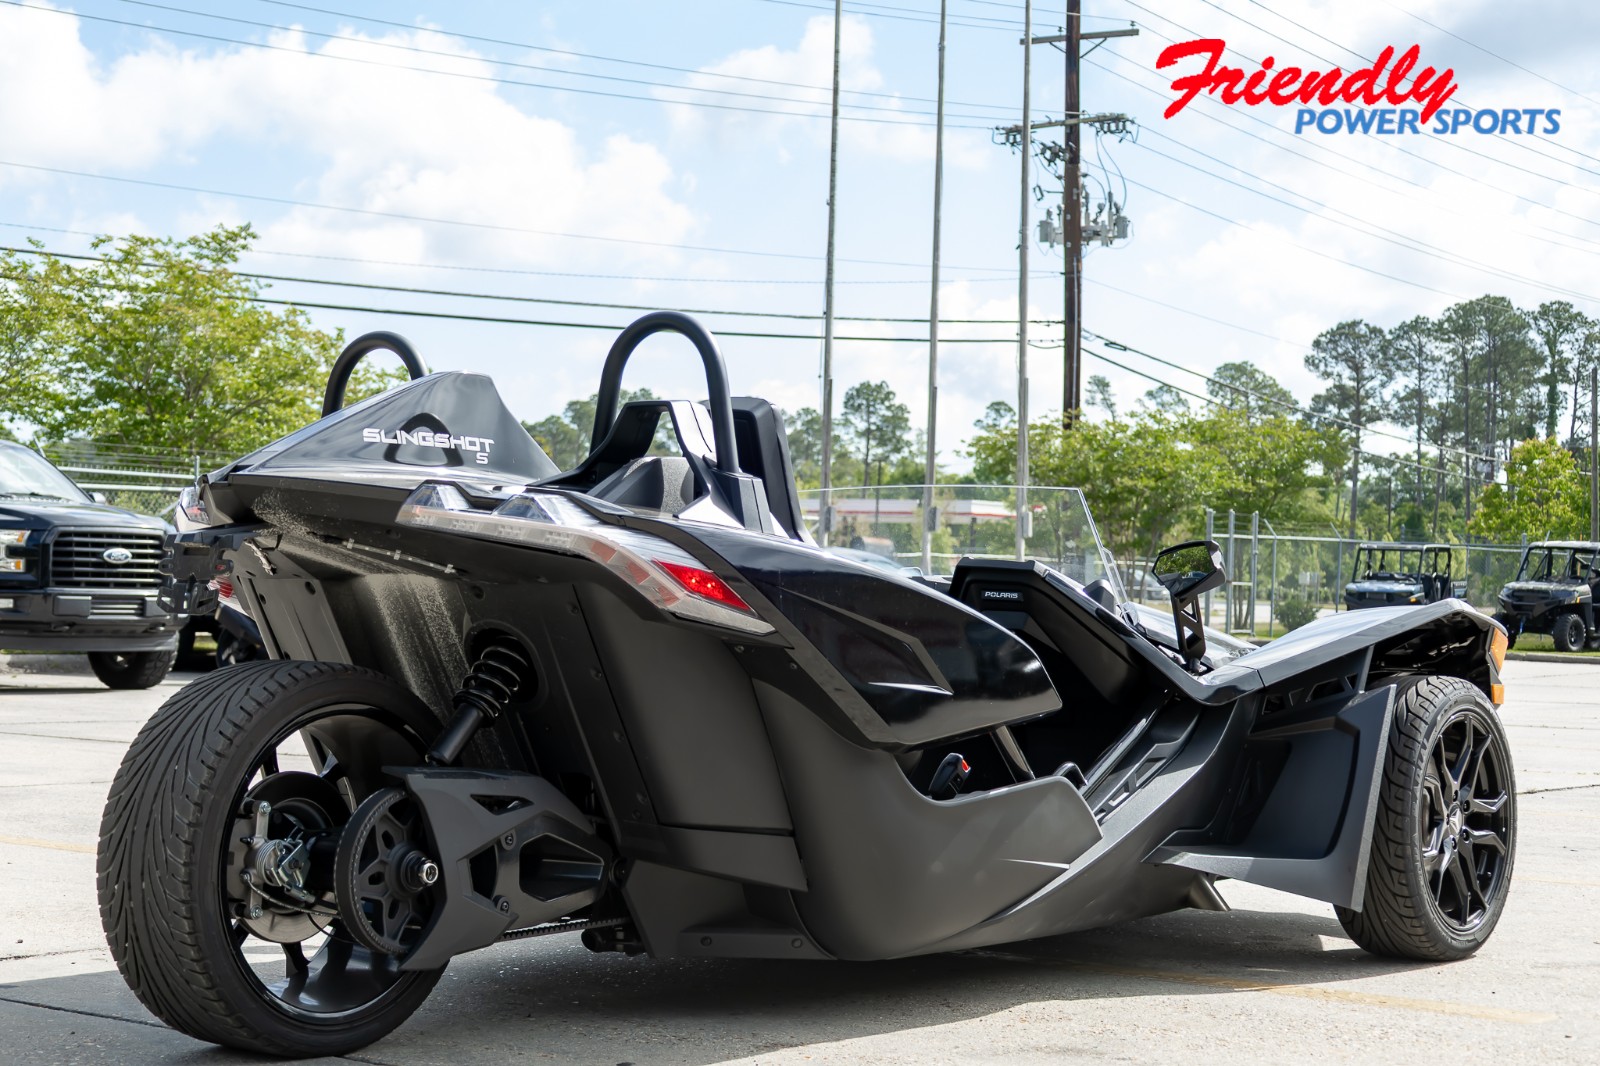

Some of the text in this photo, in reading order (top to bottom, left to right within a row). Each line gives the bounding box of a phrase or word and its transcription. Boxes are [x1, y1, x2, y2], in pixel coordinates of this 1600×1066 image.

[362, 427, 495, 453] SLINGSHOT
[475, 452, 489, 465] S
[984, 591, 1018, 599] POLARIS
